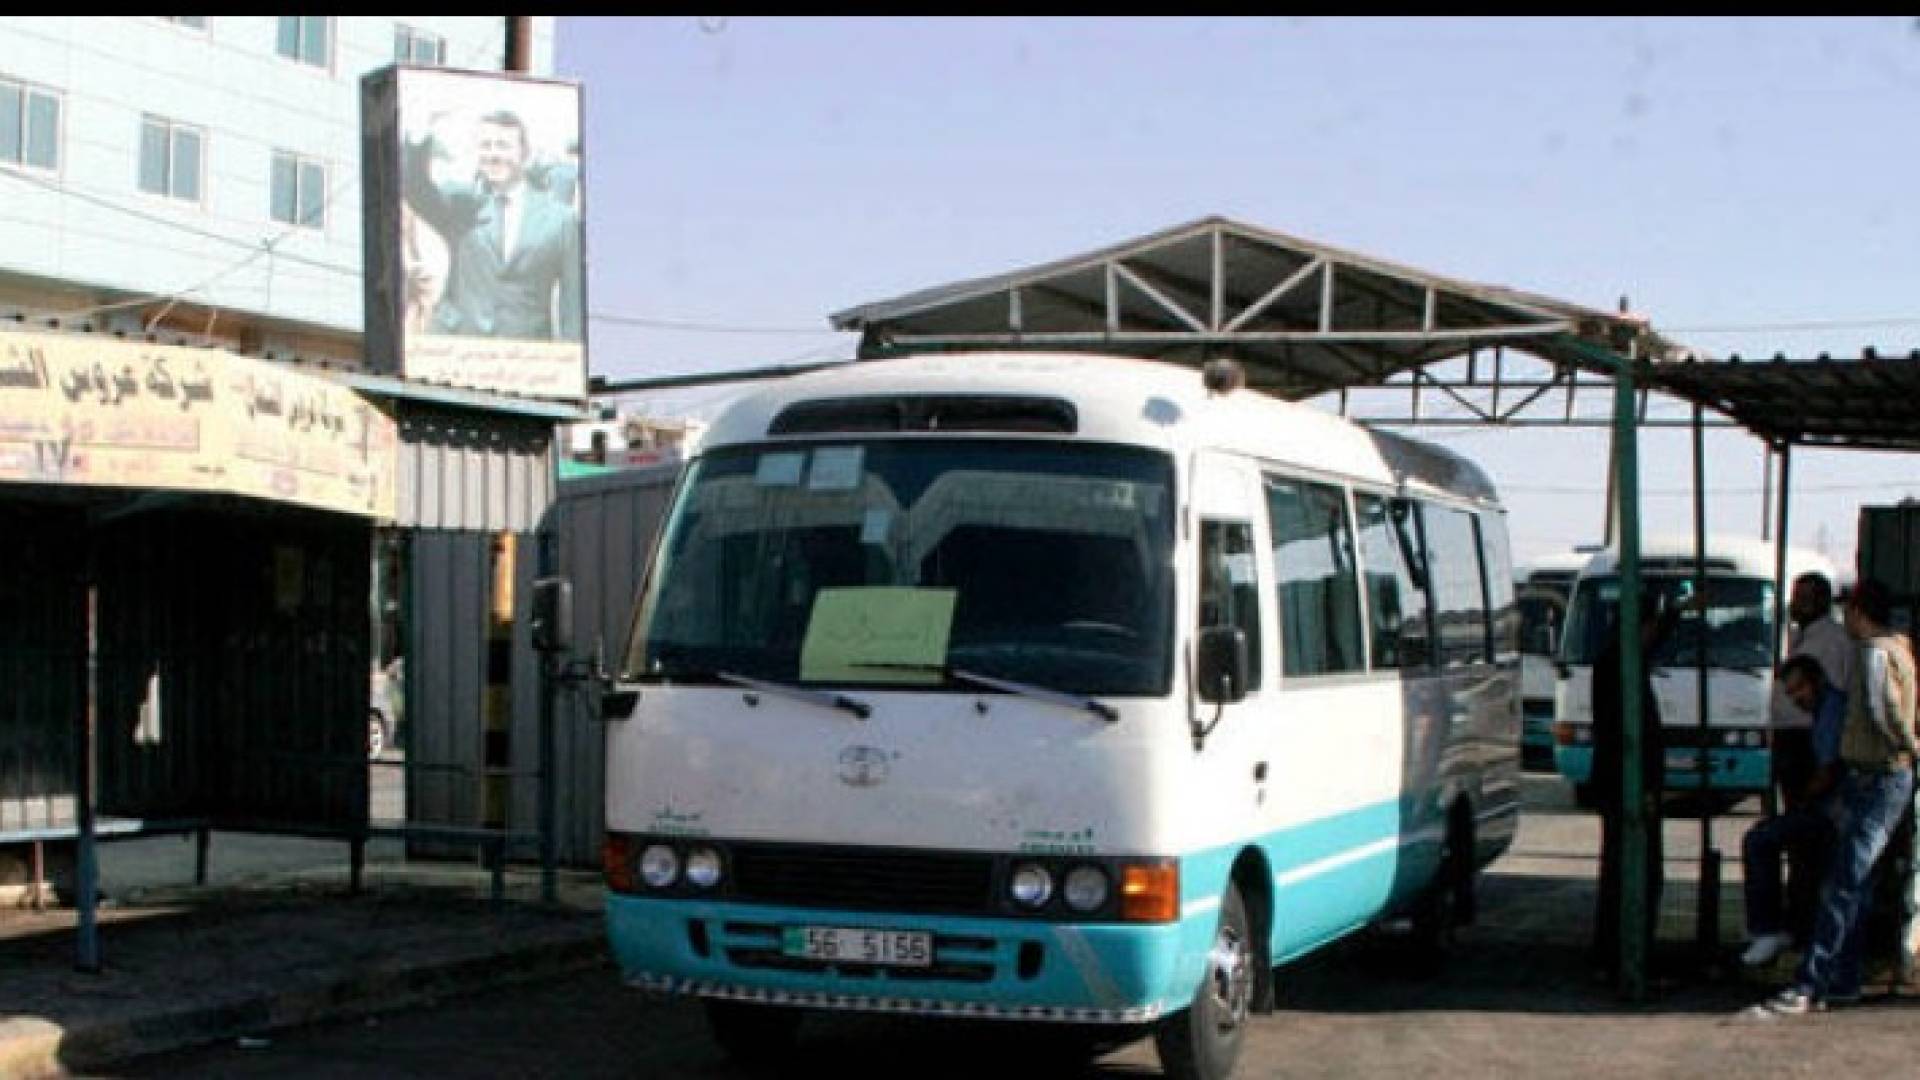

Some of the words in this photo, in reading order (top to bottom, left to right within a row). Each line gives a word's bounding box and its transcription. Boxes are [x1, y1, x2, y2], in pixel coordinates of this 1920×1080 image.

[146, 354, 214, 411] شركة
[808, 928, 838, 959] 56
[863, 933, 925, 961] 5156
